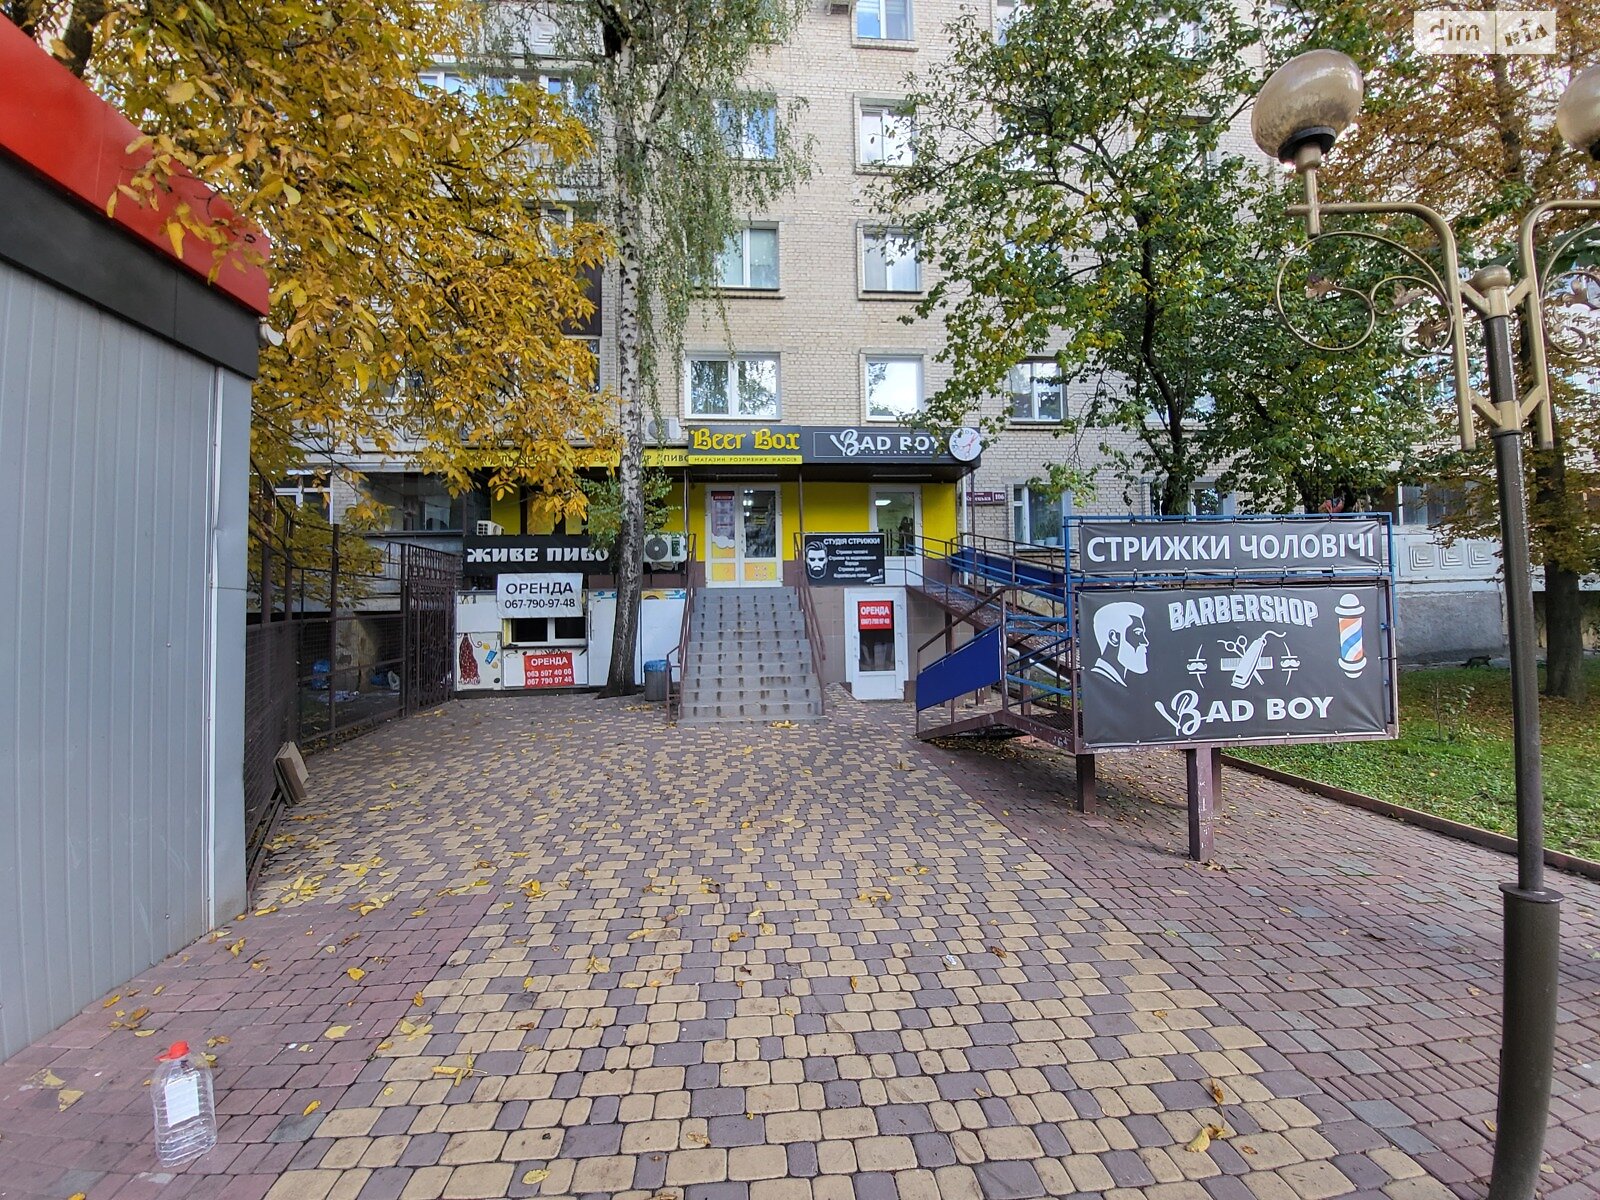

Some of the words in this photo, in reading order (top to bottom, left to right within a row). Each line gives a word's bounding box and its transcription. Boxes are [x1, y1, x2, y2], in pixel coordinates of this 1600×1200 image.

[690, 428, 747, 450] Beer
[751, 428, 800, 450] Box
[466, 548, 539, 562] ЖИВЕ
[546, 547, 610, 562] ПИВО
[1086, 535, 1231, 563] СТРИЖКИ
[1240, 532, 1374, 560] ЧОЛОВІЧІ
[506, 582, 573, 595] ОРЕНДА
[504, 598, 576, 609] 067-790-97-48
[860, 606, 890, 615] ОРЕНДА
[1168, 594, 1319, 632] BARBERSHOP
[531, 657, 568, 666] ОРЕНДА
[1266, 696, 1334, 721] BOY
